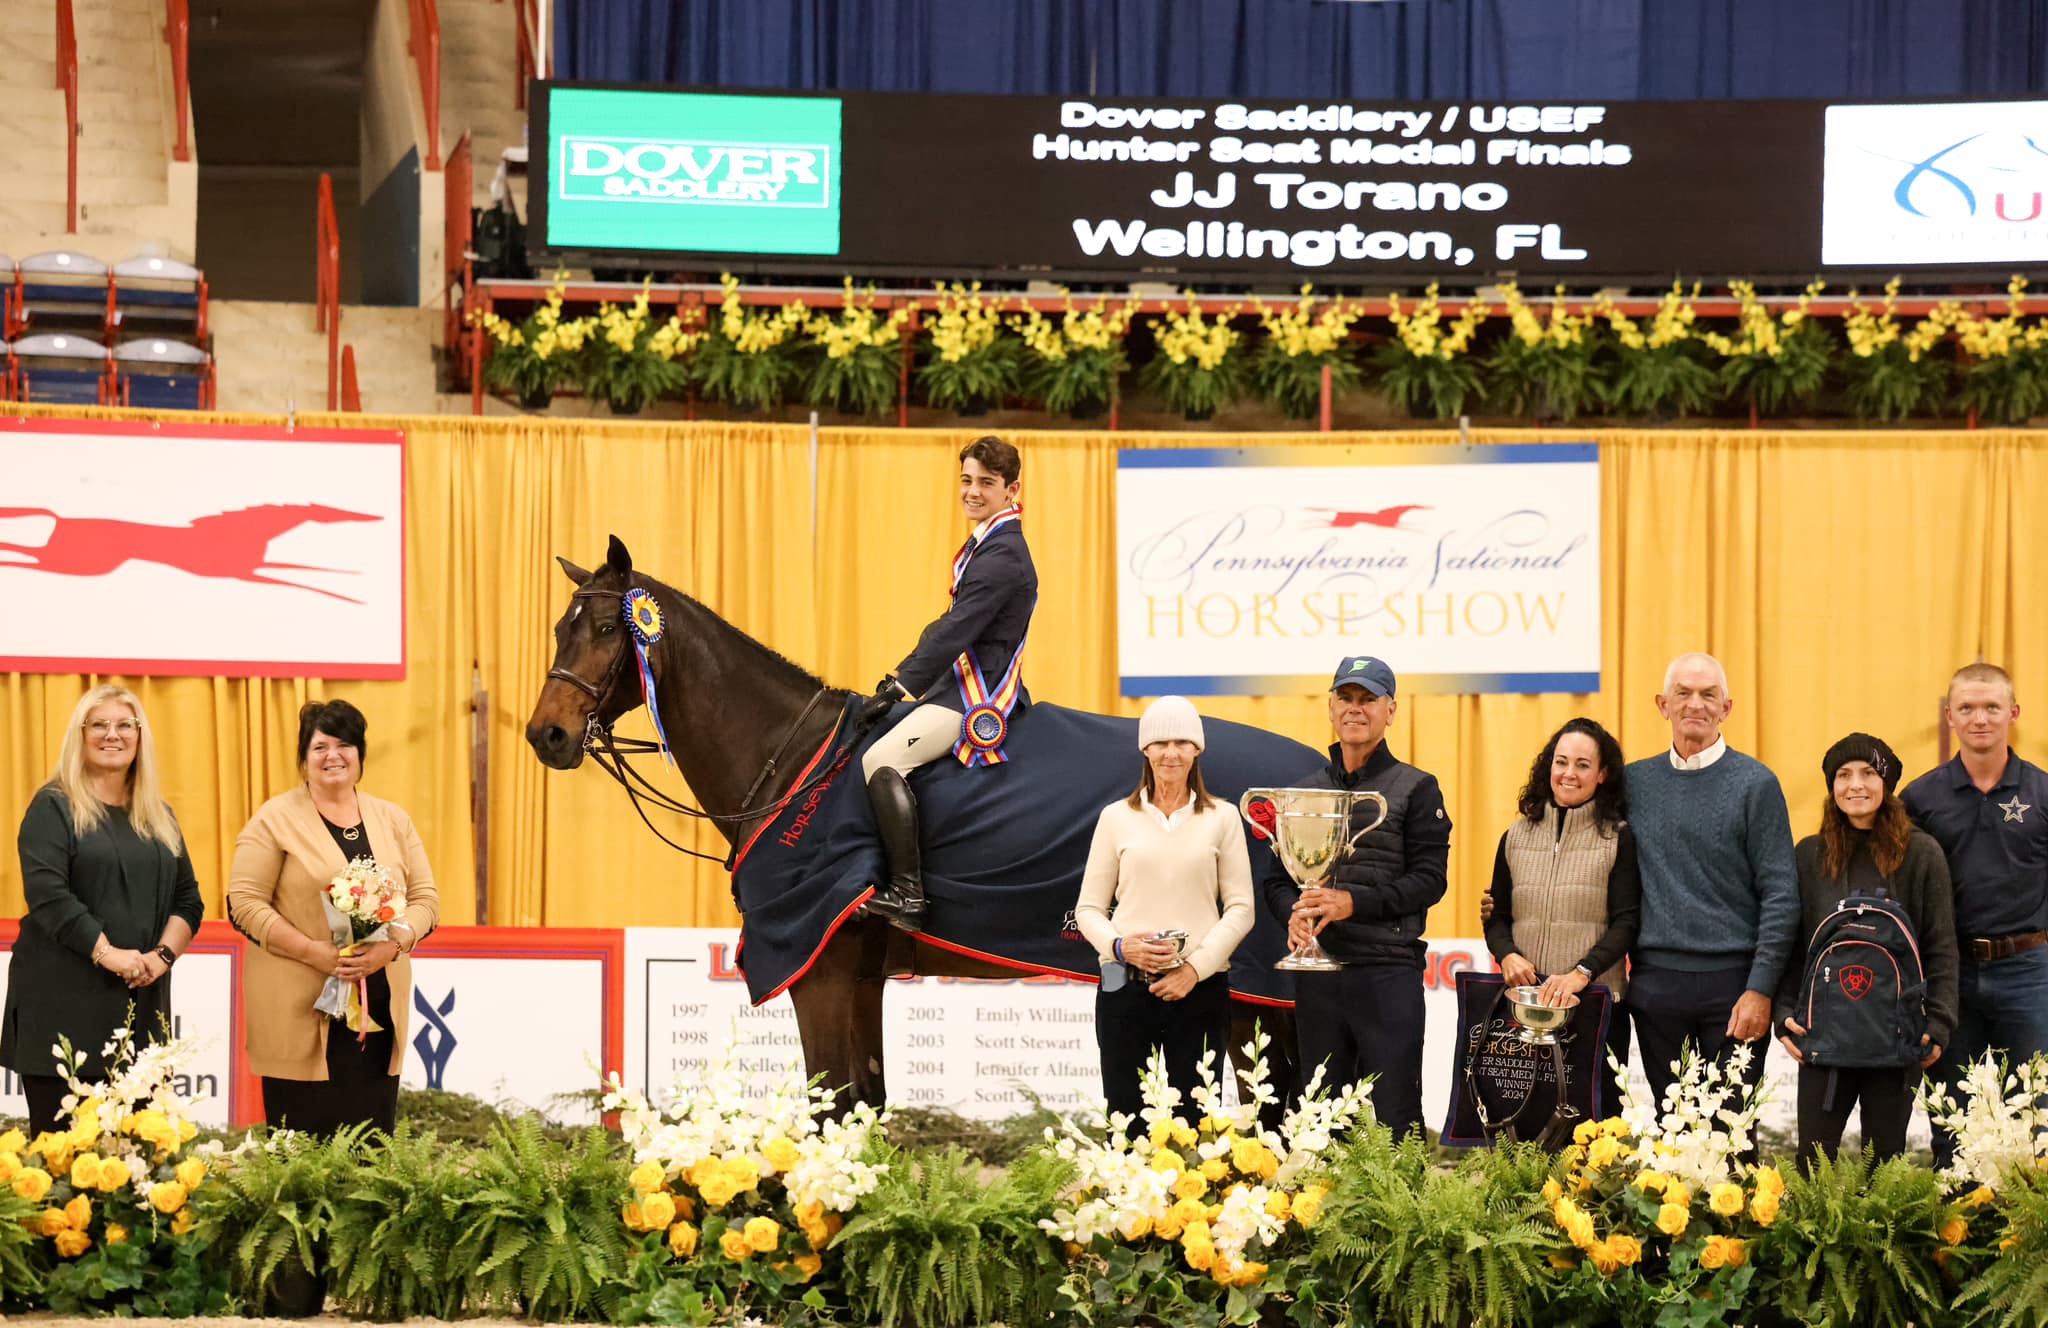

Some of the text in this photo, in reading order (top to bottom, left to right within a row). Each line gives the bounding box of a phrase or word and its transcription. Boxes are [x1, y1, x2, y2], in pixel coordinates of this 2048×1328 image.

[1061, 101, 1605, 137] Dover Saddlery / USEF
[1033, 133, 1631, 166] Hunter Seat Medal Finals
[570, 143, 819, 184] DOVER
[603, 176, 784, 201] SADDLERY
[1151, 171, 1508, 211] JJ Torano
[1073, 218, 1588, 267] Wellington, FL
[1134, 506, 1588, 602] Pennsylvania National
[1147, 591, 1566, 638] HORSE SHOW
[671, 1003, 794, 1019] 1997 Robert
[906, 1006, 945, 1021] 2002
[975, 1007, 1024, 1027] Emily
[671, 1031, 709, 1045] 1998
[906, 1033, 1081, 1050] 2003 Scott Stewart
[671, 1058, 709, 1072] 1999
[906, 1061, 945, 1075] 2004
[1045, 1062, 1100, 1077] Alfano
[906, 1088, 945, 1102] 2005
[974, 1088, 1015, 1103] Scott
[1501, 1088, 1524, 1100] 2024
